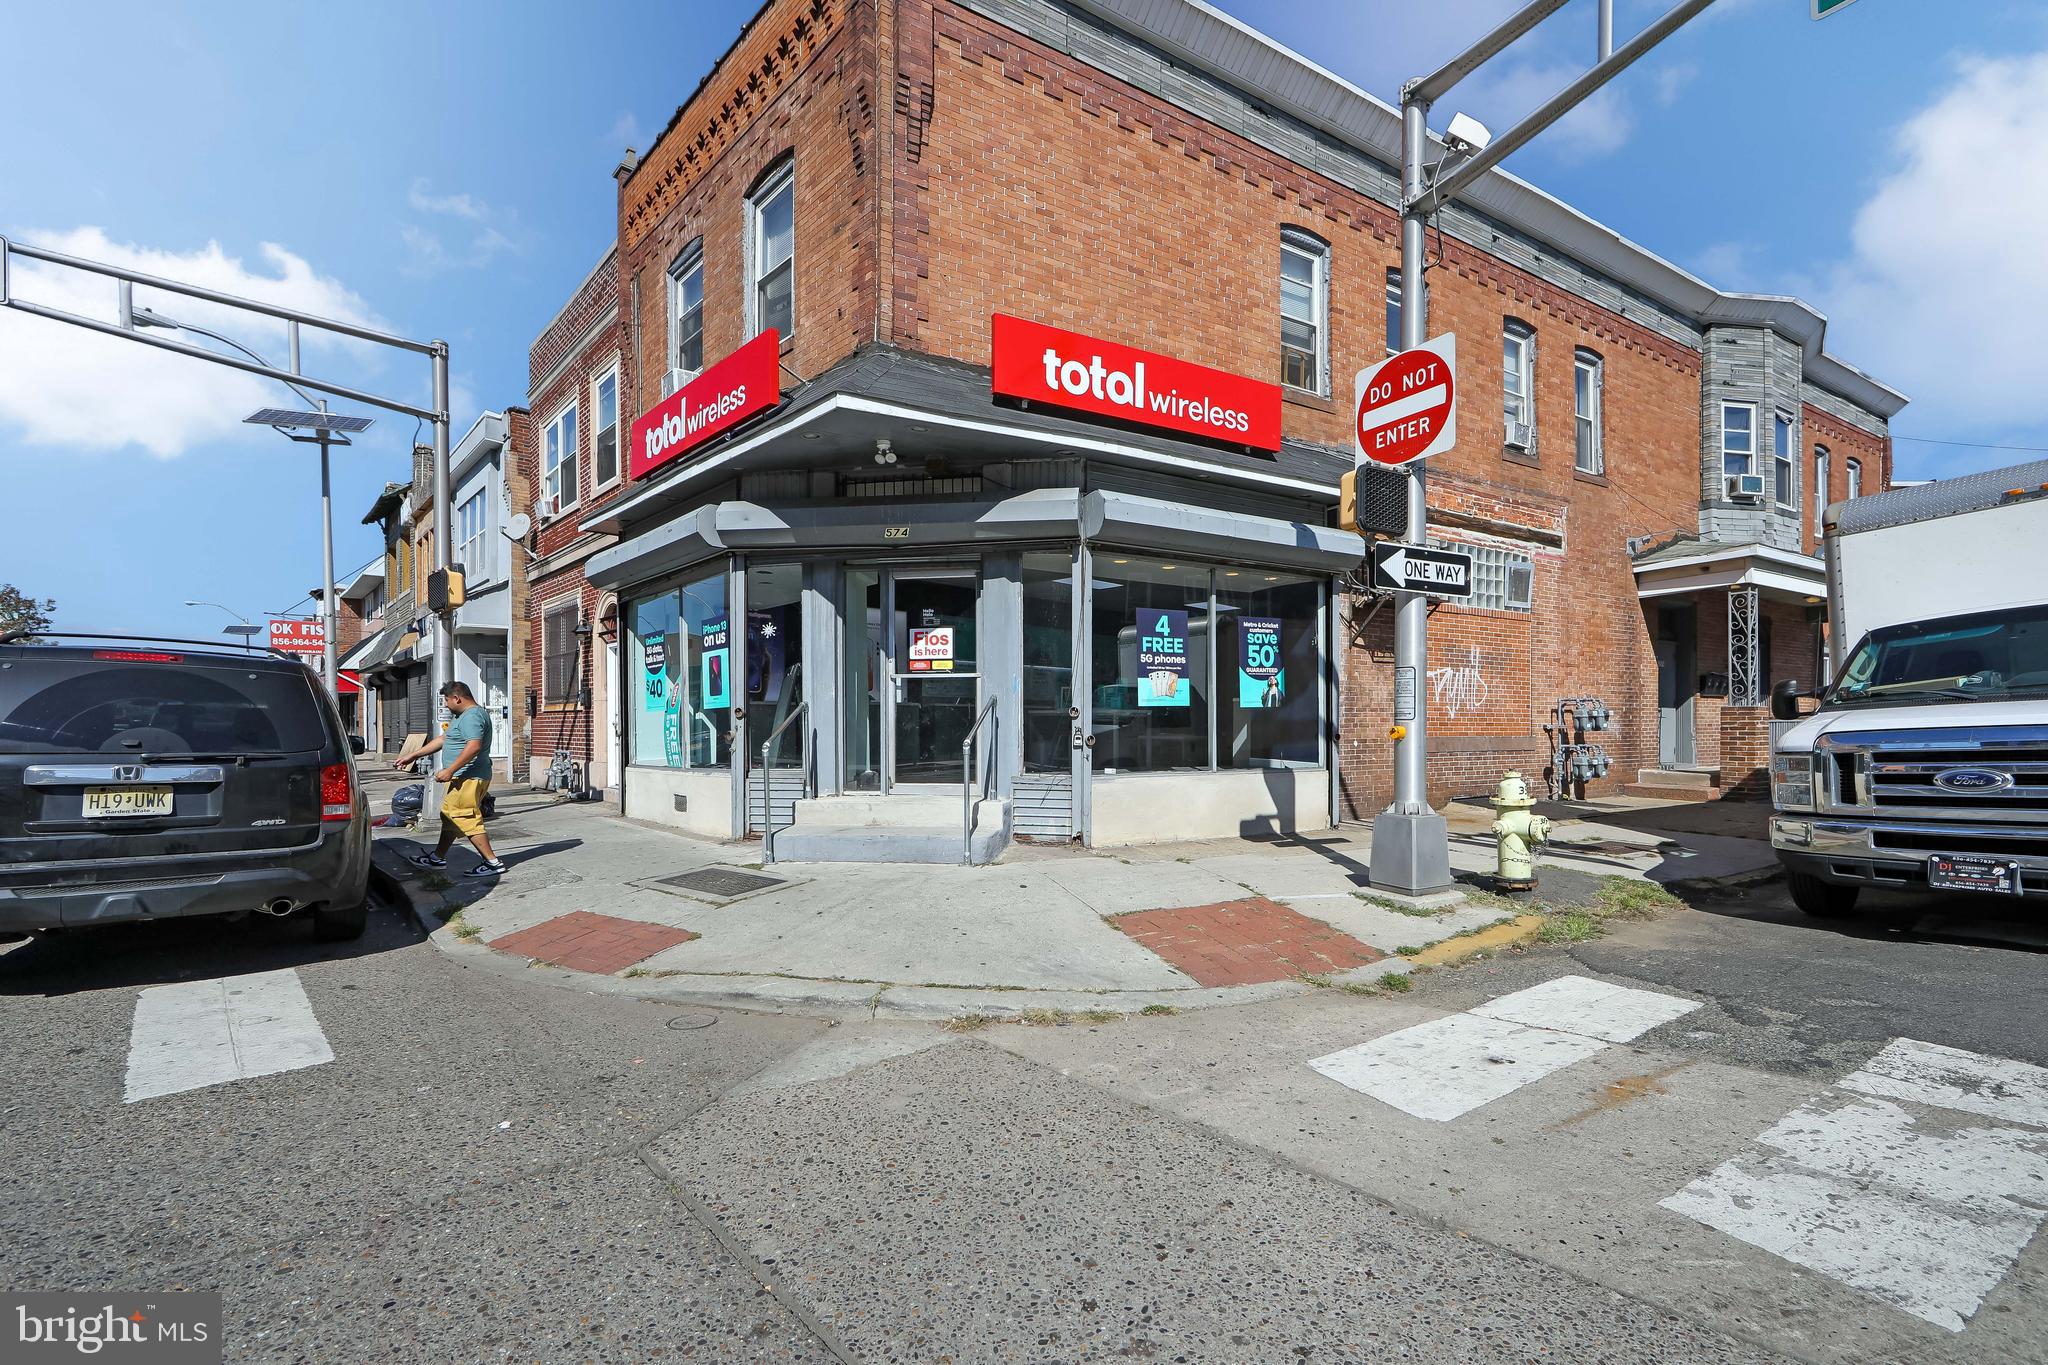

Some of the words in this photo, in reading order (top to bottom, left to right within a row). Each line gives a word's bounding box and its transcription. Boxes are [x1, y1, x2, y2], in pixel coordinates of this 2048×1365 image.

[1043, 348, 1145, 409] total
[1148, 389, 1249, 433] wireless
[1370, 382, 1392, 405] DO
[1402, 362, 1438, 392] NOT
[646, 396, 687, 459] total
[687, 385, 746, 435] wireless
[1375, 416, 1431, 450] ENTER
[885, 528, 908, 537] 574
[1404, 559, 1431, 580] ONE
[1435, 562, 1462, 583] WAY
[271, 623, 293, 635] OK
[301, 624, 325, 636] FIS
[702, 624, 720, 635] iPhone
[720, 620, 727, 631] 13
[1155, 615, 1171, 636] 4
[703, 636, 714, 648] on
[715, 632, 726, 645] us
[913, 631, 949, 646] Fios
[1142, 636, 1184, 654] FREE
[1247, 633, 1278, 645] save
[914, 647, 923, 656] is
[924, 646, 948, 656] here
[1140, 654, 1153, 663] 5G
[1154, 653, 1186, 665] phones
[646, 679, 663, 698] $40
[670, 714, 680, 766] FREE
[1953, 774, 1986, 785] Ford
[251, 819, 286, 827] 4WD
[1939, 862, 1953, 871] DJ
